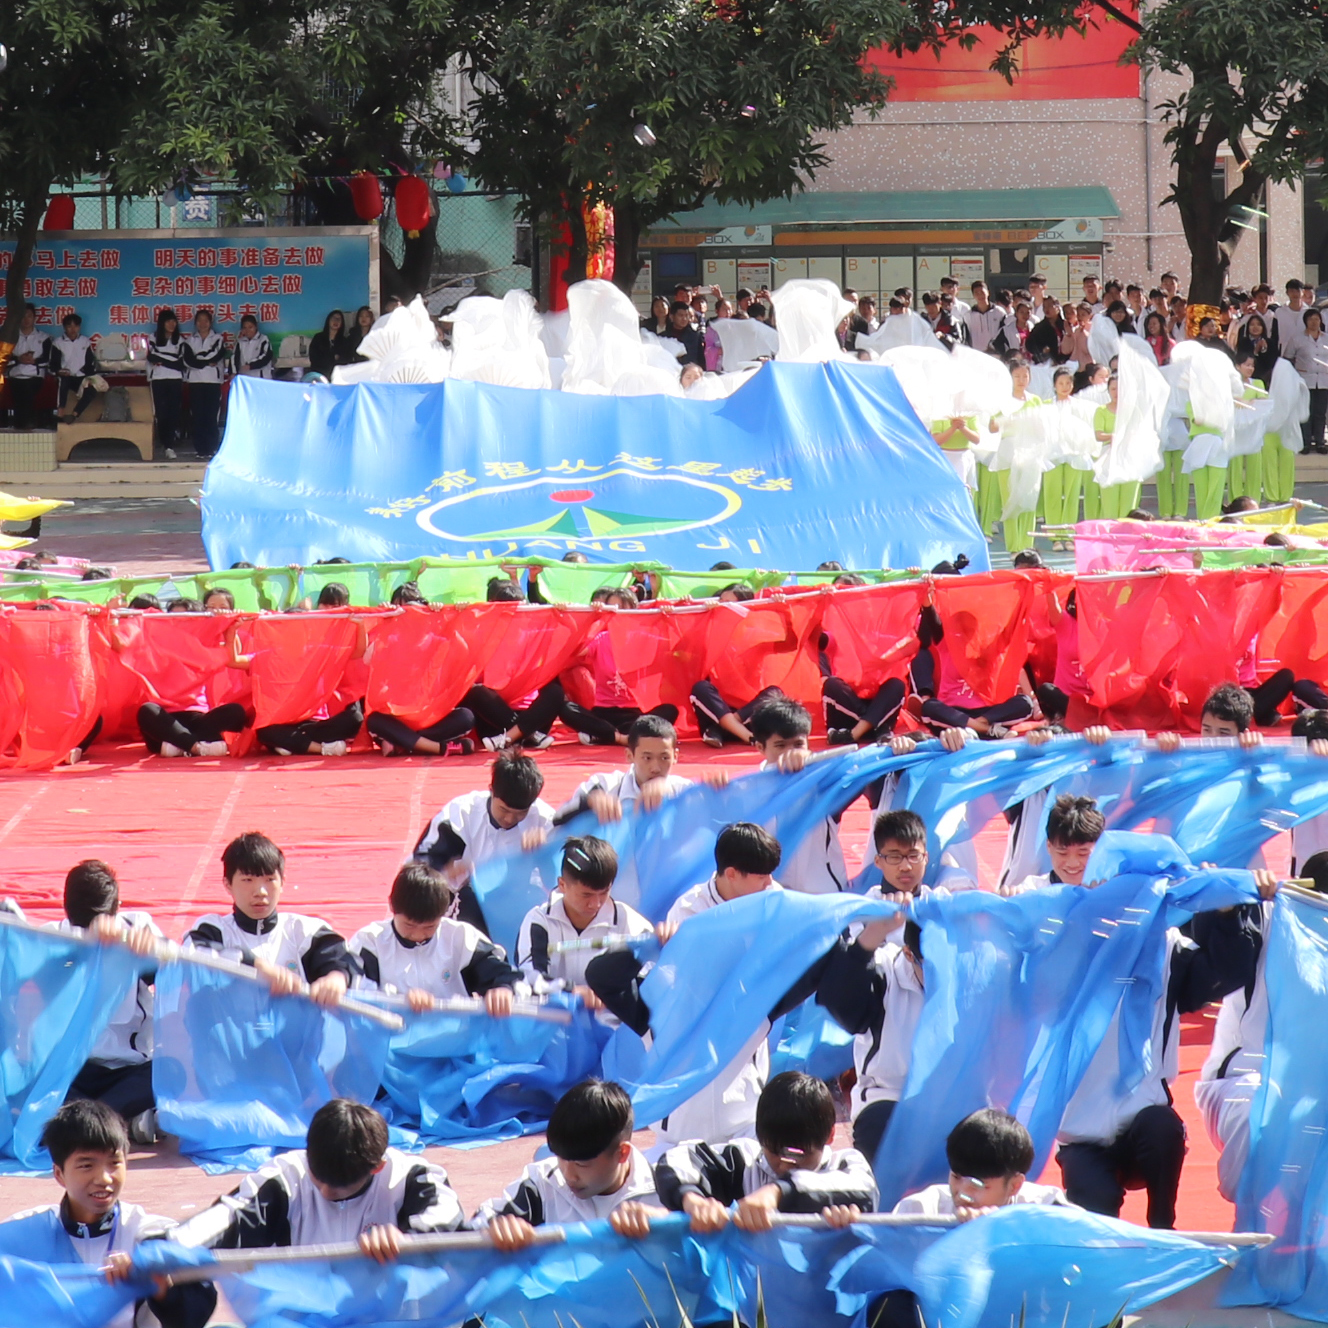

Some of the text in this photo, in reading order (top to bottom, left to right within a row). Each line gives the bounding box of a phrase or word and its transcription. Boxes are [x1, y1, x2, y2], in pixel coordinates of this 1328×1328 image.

[154, 246, 324, 269] 明天的事准备去做
[1038, 257, 1050, 270] C
[707, 261, 717, 273] B
[848, 259, 858, 271] B
[919, 258, 930, 270] A
[132, 274, 303, 297] 复杂的事细心去做
